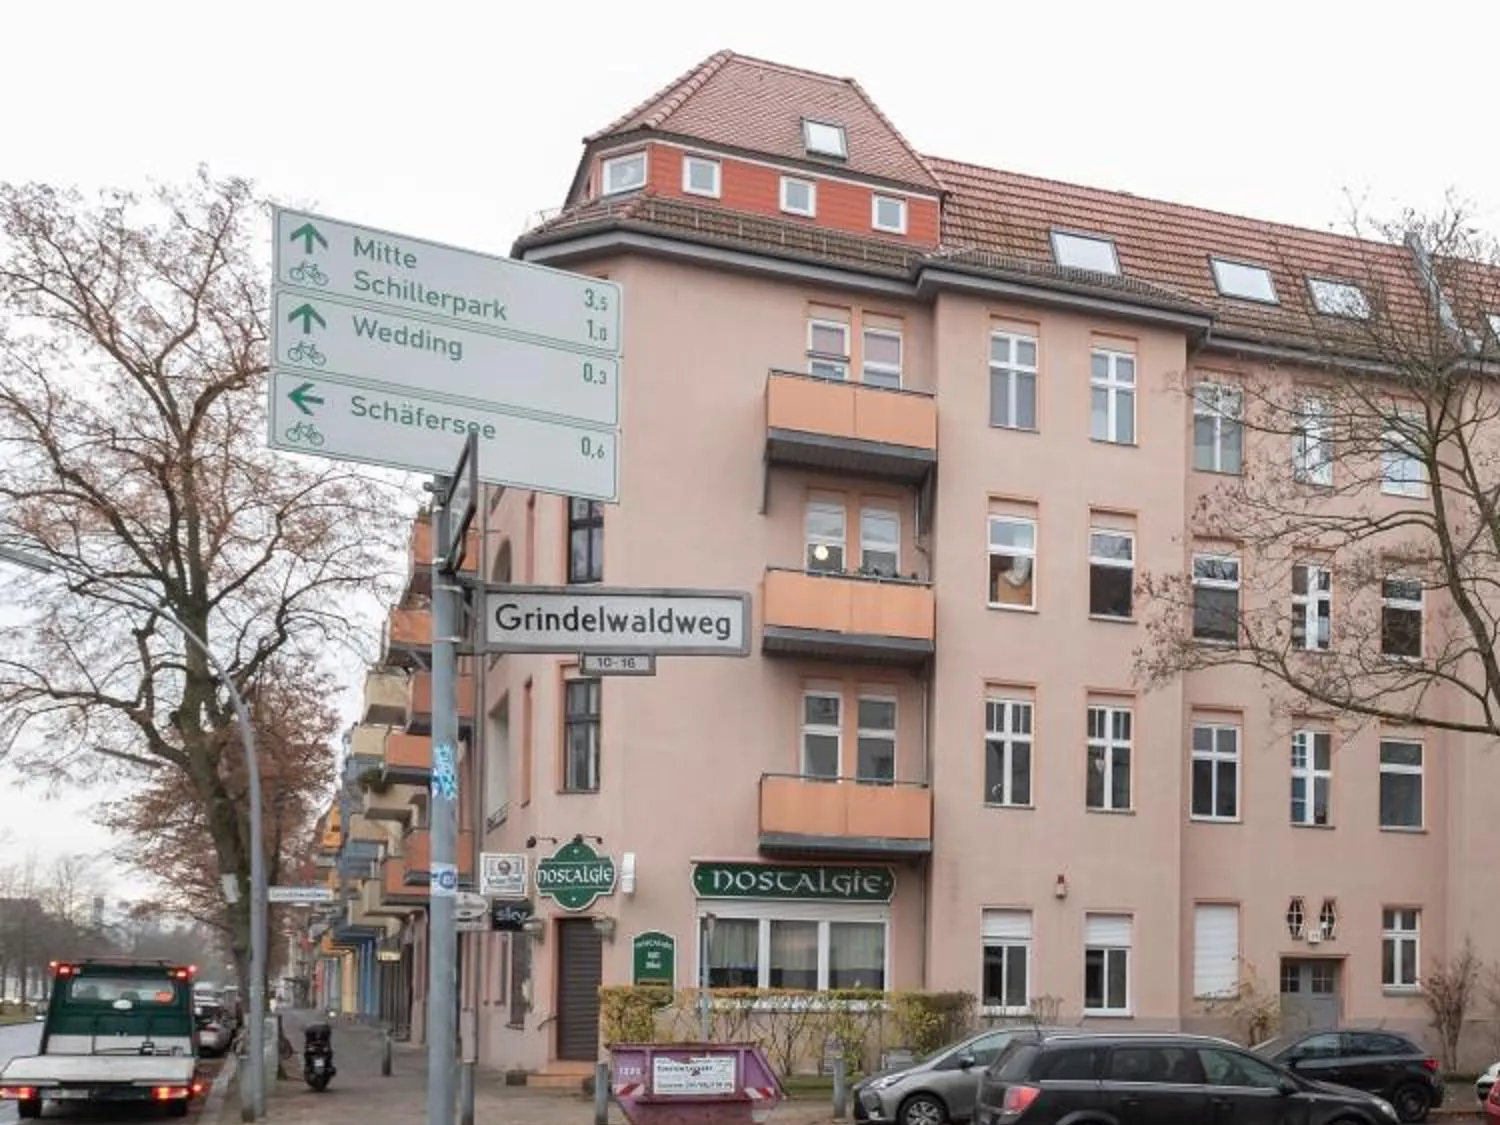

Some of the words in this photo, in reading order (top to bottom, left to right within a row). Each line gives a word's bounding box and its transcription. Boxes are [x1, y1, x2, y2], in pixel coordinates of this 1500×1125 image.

[353, 236, 417, 270] Mitte
[353, 270, 508, 322] Schillerpark
[353, 316, 464, 361] Wedding
[350, 396, 497, 440] Schäfersee
[495, 603, 733, 640] Grindelwaldweg
